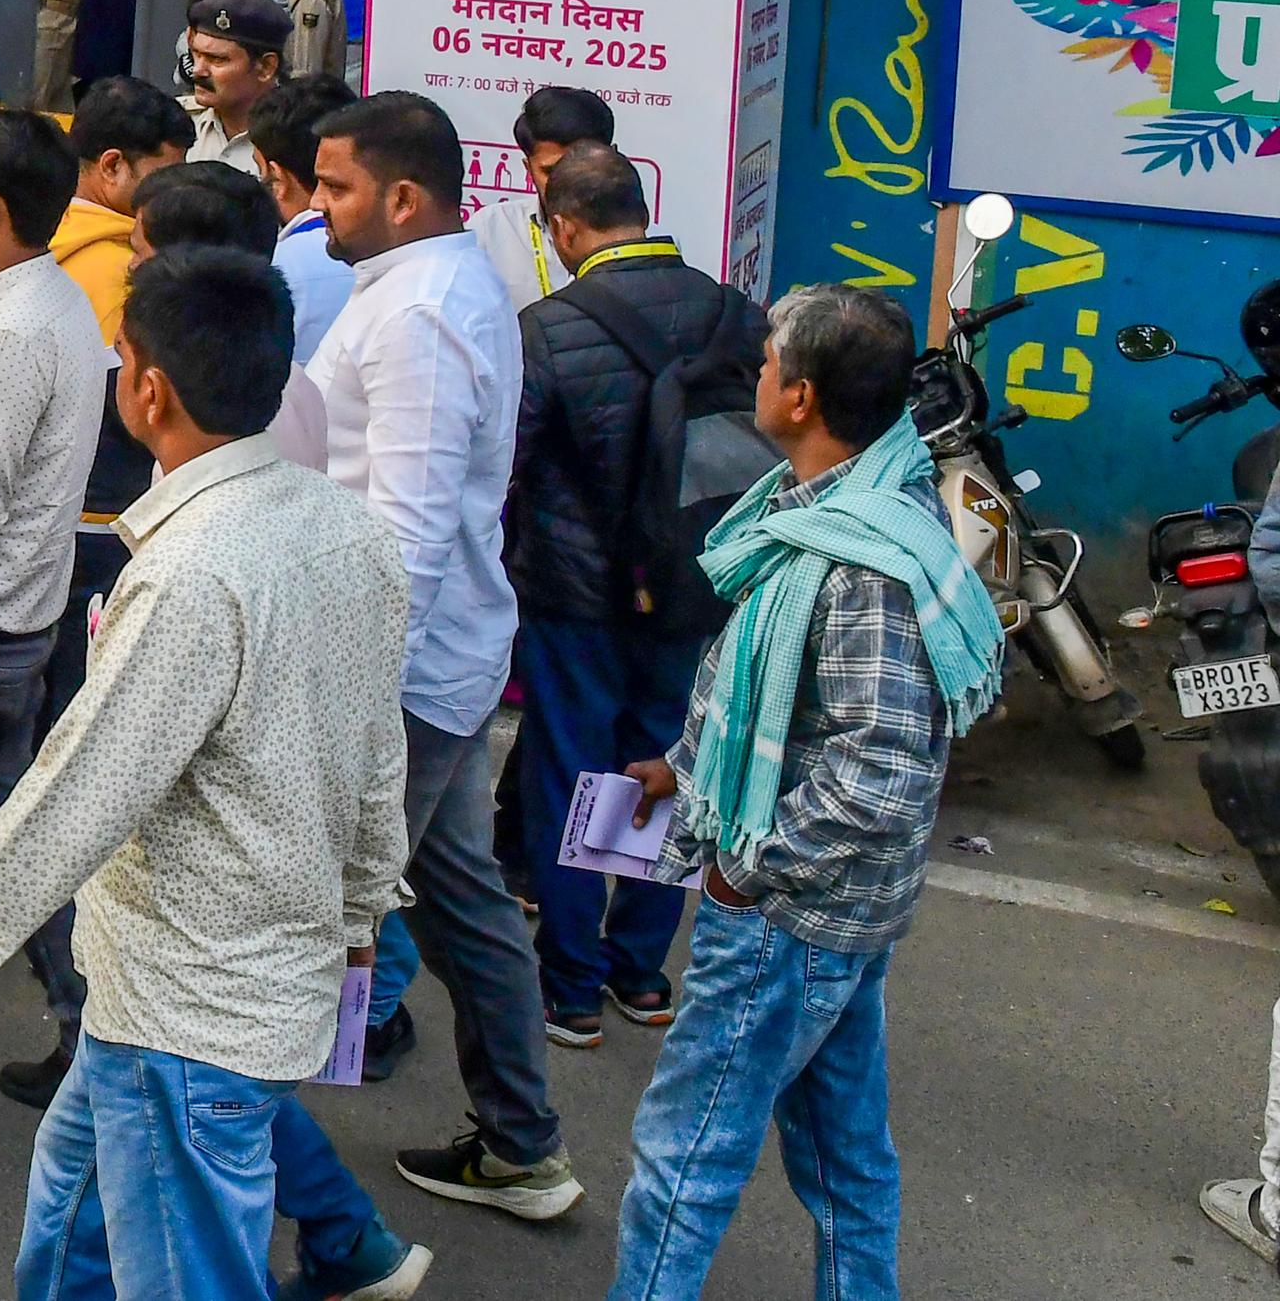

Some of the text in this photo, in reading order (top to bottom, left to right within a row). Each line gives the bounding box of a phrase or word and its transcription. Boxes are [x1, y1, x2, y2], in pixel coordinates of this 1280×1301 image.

[432, 26, 667, 71] 06 नवंबर, 2025
[495, 77, 518, 94] बजे
[522, 78, 536, 94] से
[616, 88, 641, 105] बजे
[645, 93, 672, 107] तक
[1191, 660, 1261, 690] BR01F
[1197, 683, 1271, 713] X3323
